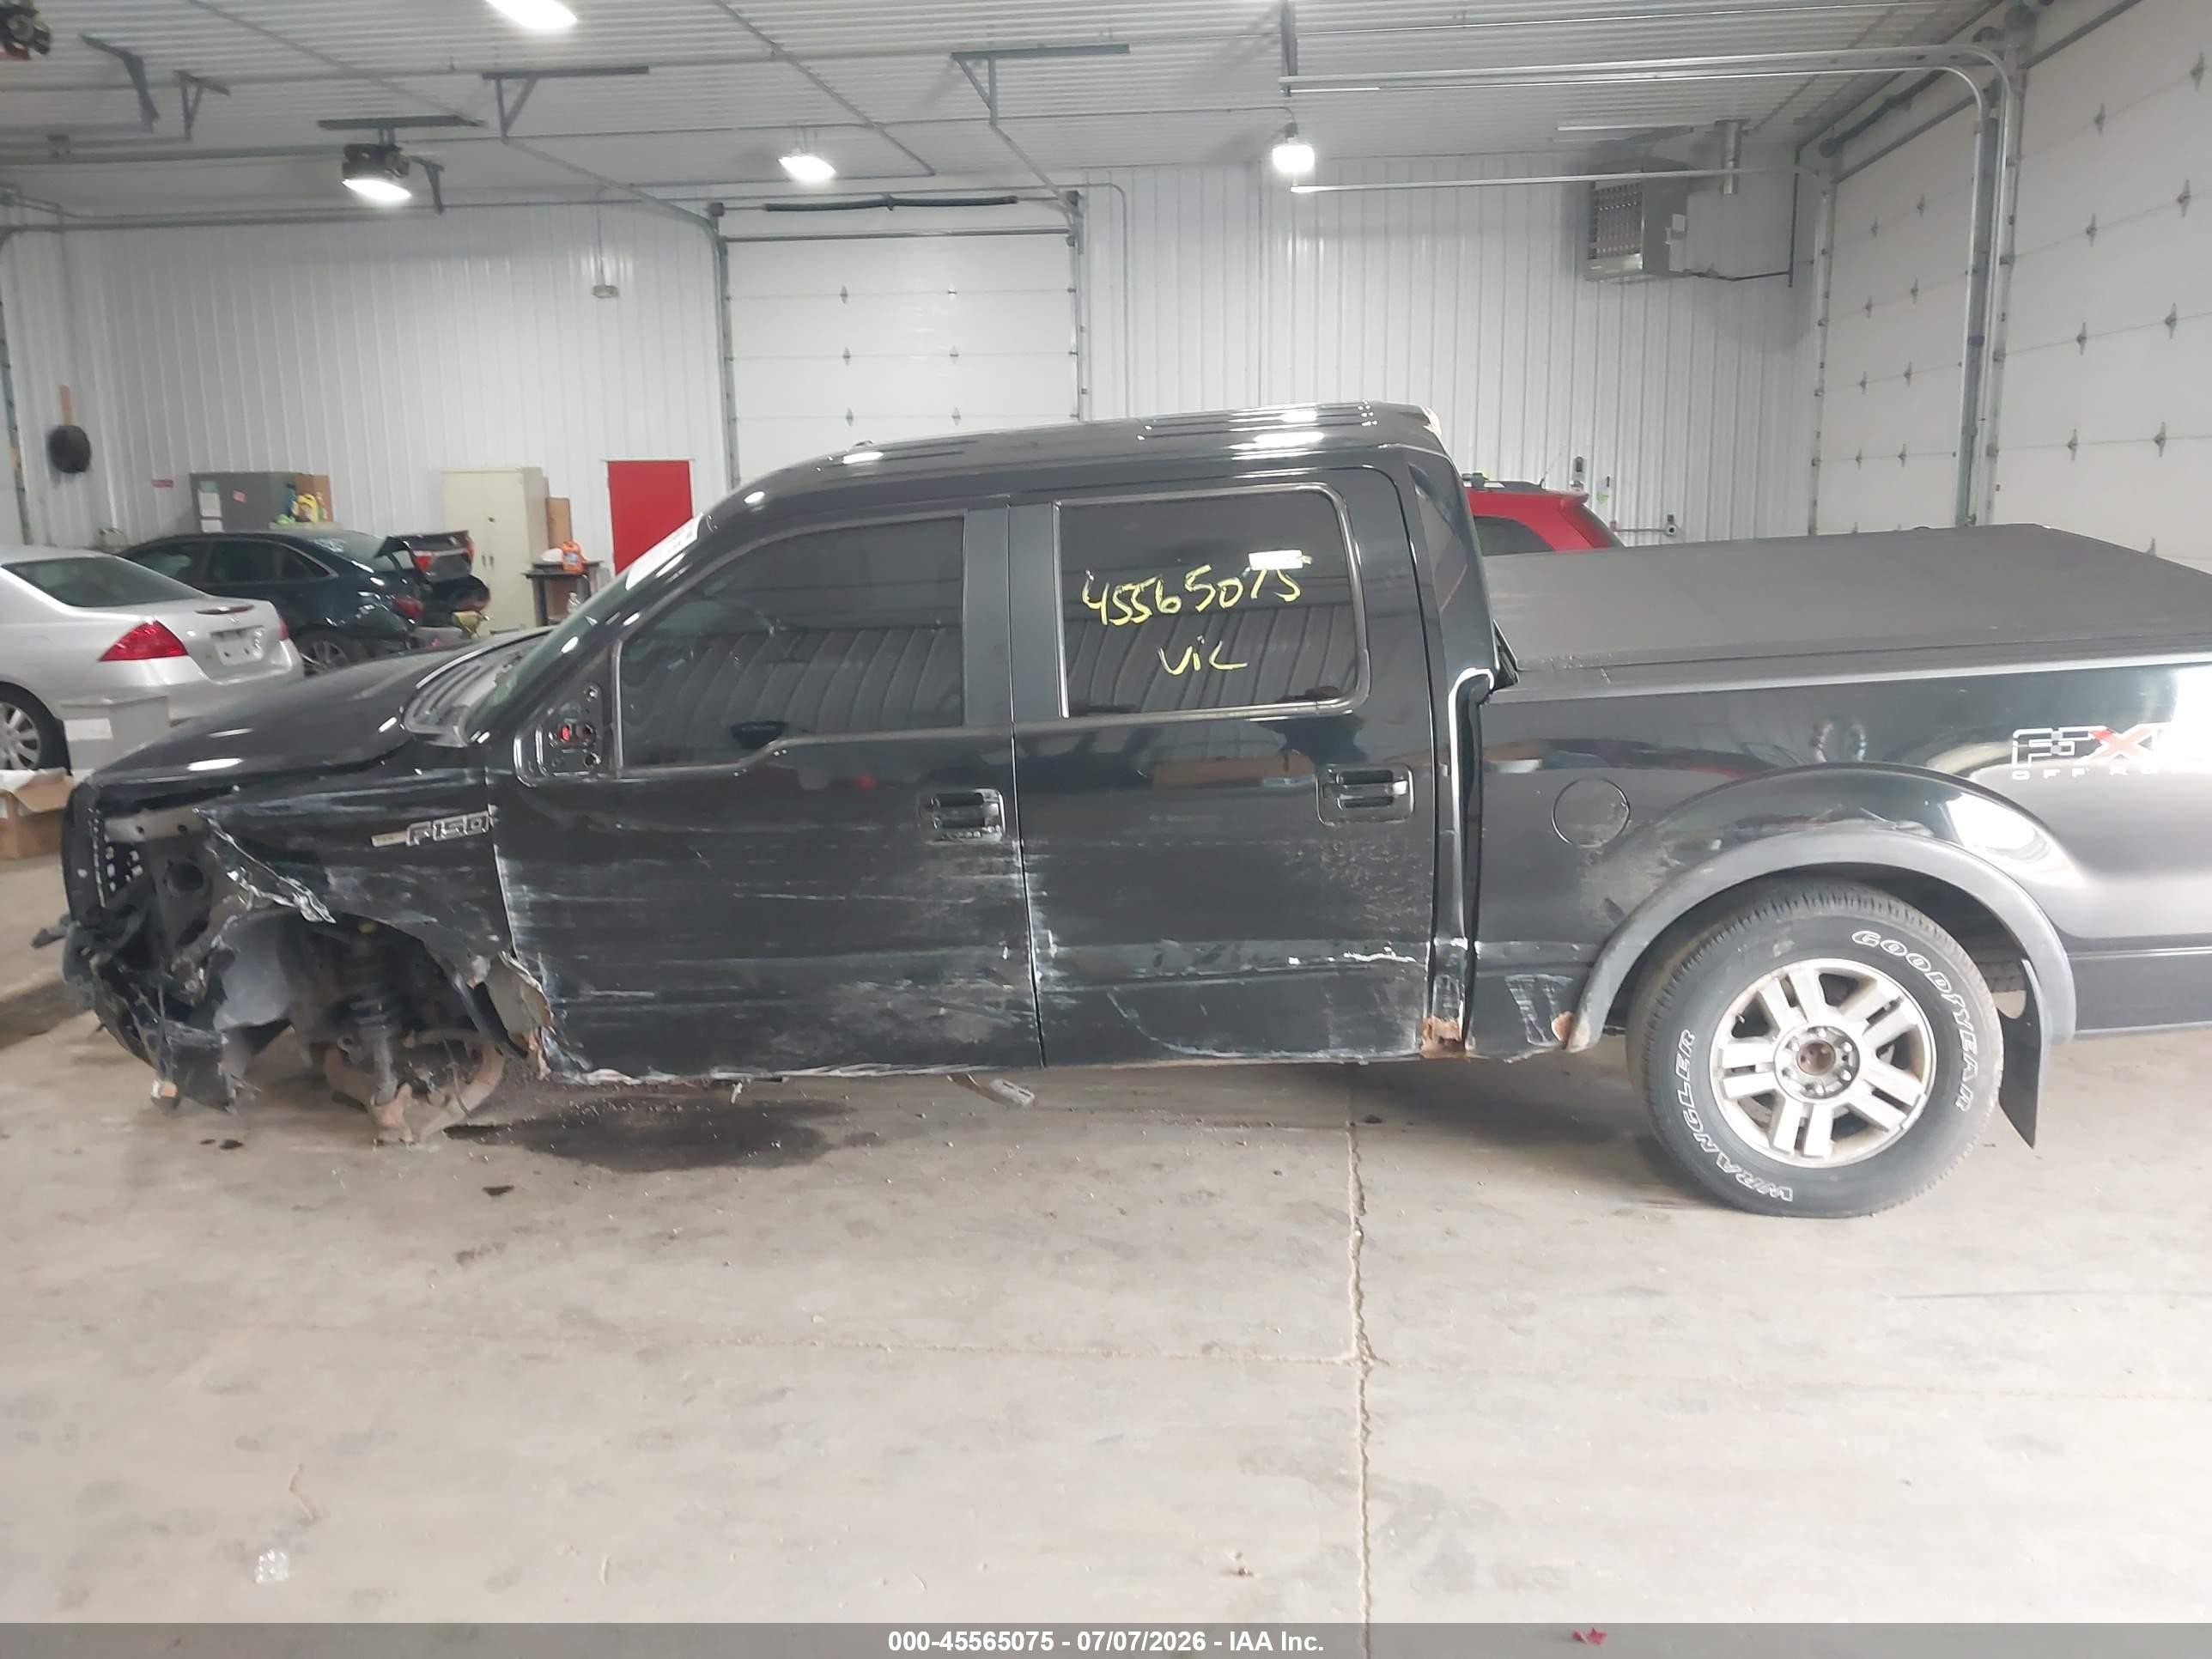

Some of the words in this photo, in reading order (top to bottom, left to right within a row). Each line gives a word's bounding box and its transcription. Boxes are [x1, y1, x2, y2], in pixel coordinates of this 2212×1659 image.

[2011, 723, 2191, 768] FX
[1851, 930, 1978, 1113] GOODYEAR
[1676, 1030, 1794, 1202] WRANGLER
